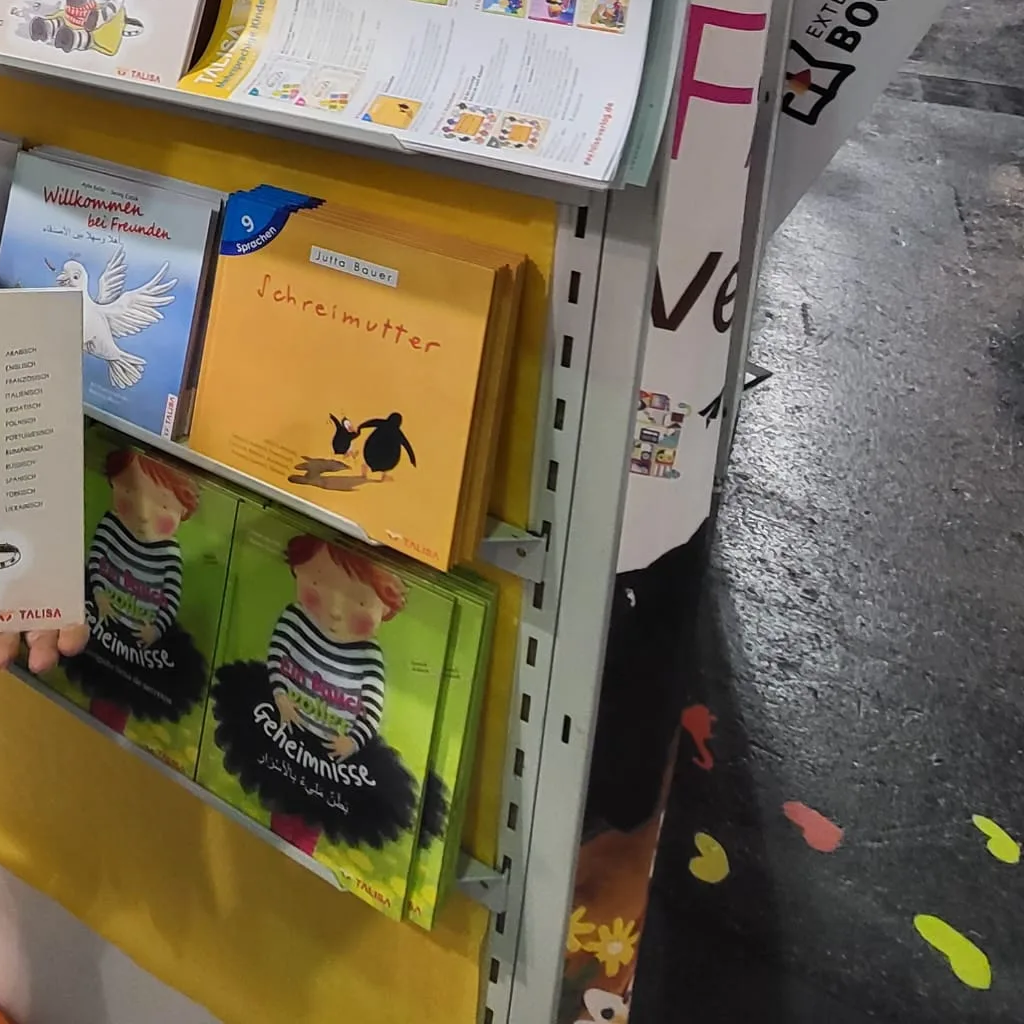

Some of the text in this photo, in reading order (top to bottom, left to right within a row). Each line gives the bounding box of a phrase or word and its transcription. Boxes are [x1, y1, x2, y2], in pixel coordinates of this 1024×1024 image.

[43, 185, 144, 217] Willkommen
[87, 214, 172, 240] bei Freunden
[241, 215, 254, 233] 9
[236, 226, 277, 254] Sprachen
[314, 251, 394, 283] Jutta Bauer
[257, 274, 441, 353] Schreimutter
[19, 608, 62, 621] TALISA
[253, 703, 376, 786] Geheimnisse
